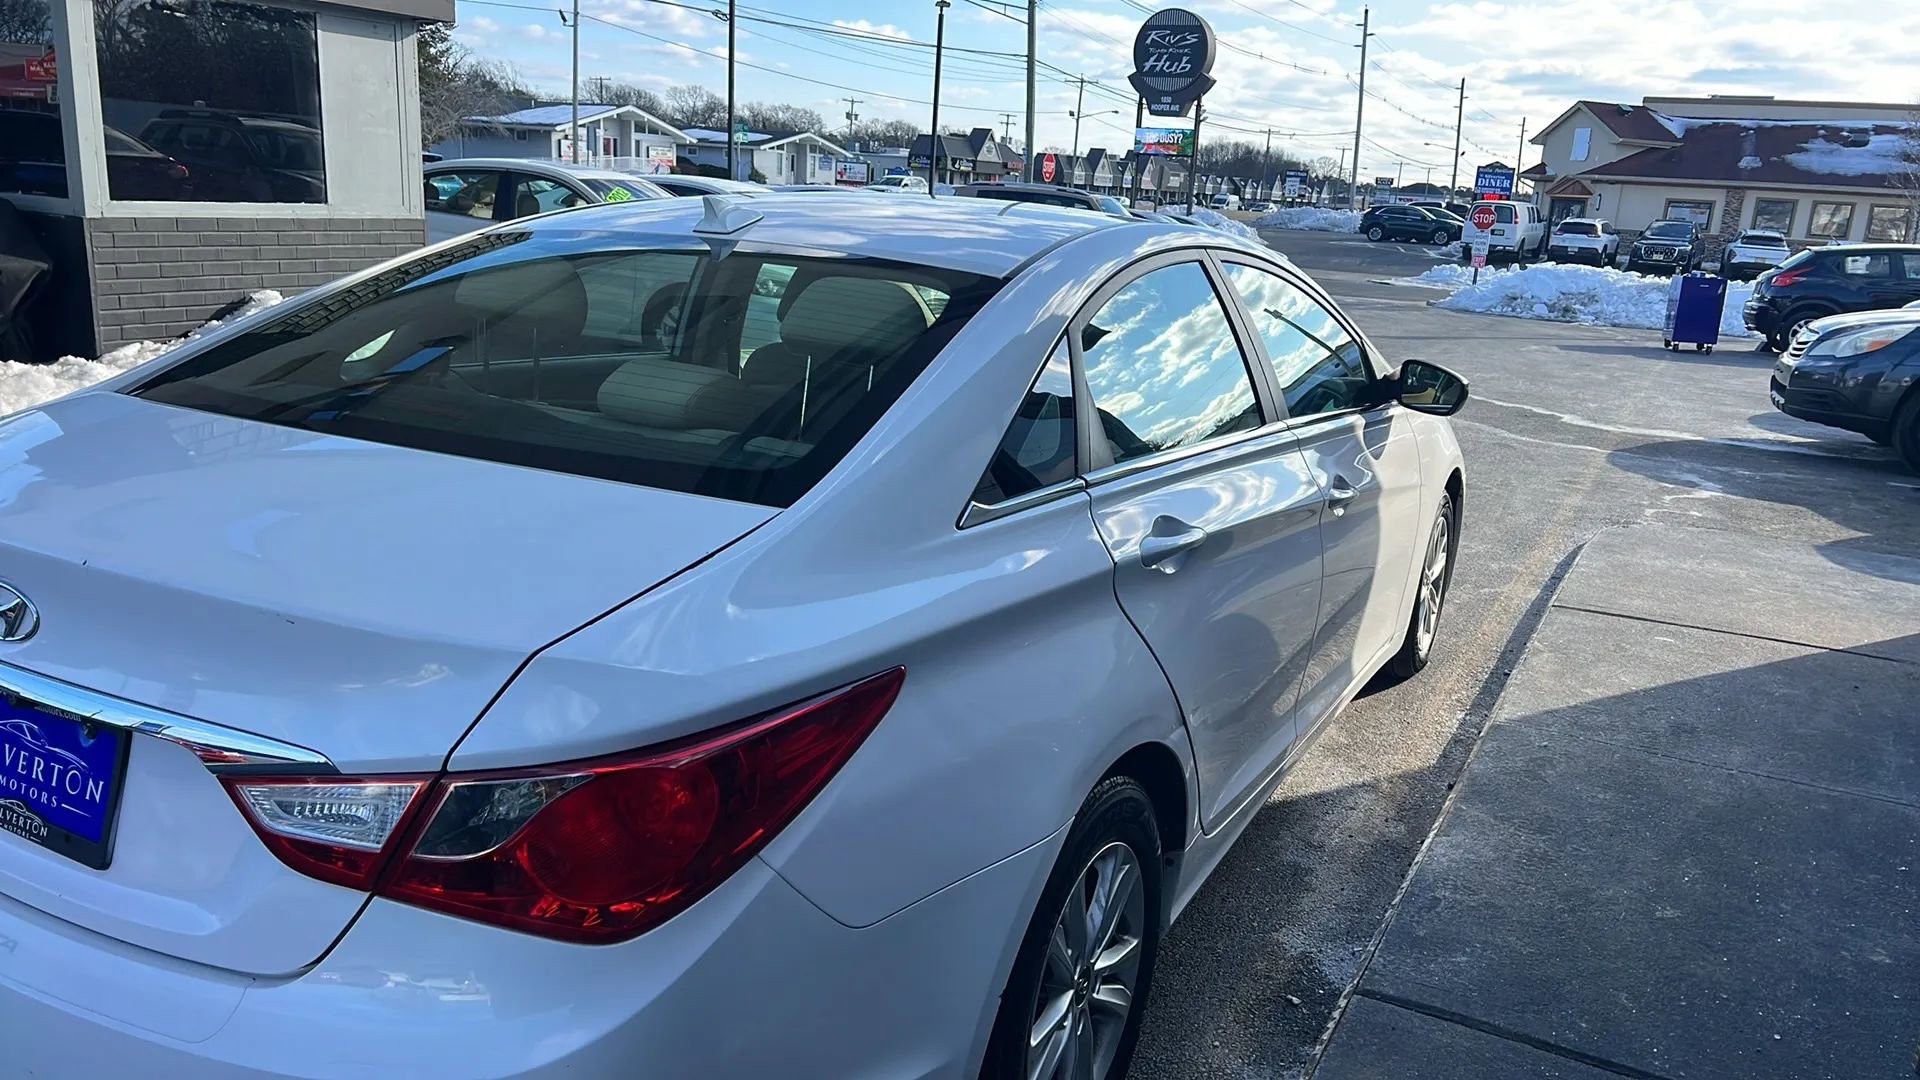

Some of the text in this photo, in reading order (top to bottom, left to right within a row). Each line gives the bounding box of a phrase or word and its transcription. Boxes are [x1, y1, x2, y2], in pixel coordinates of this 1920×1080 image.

[1143, 53, 1191, 74] Hub
[1160, 132, 1183, 144] BUSY?
[1477, 178, 1511, 188] DINER
[1473, 213, 1495, 223] STOP
[5, 743, 104, 804] VERTON
